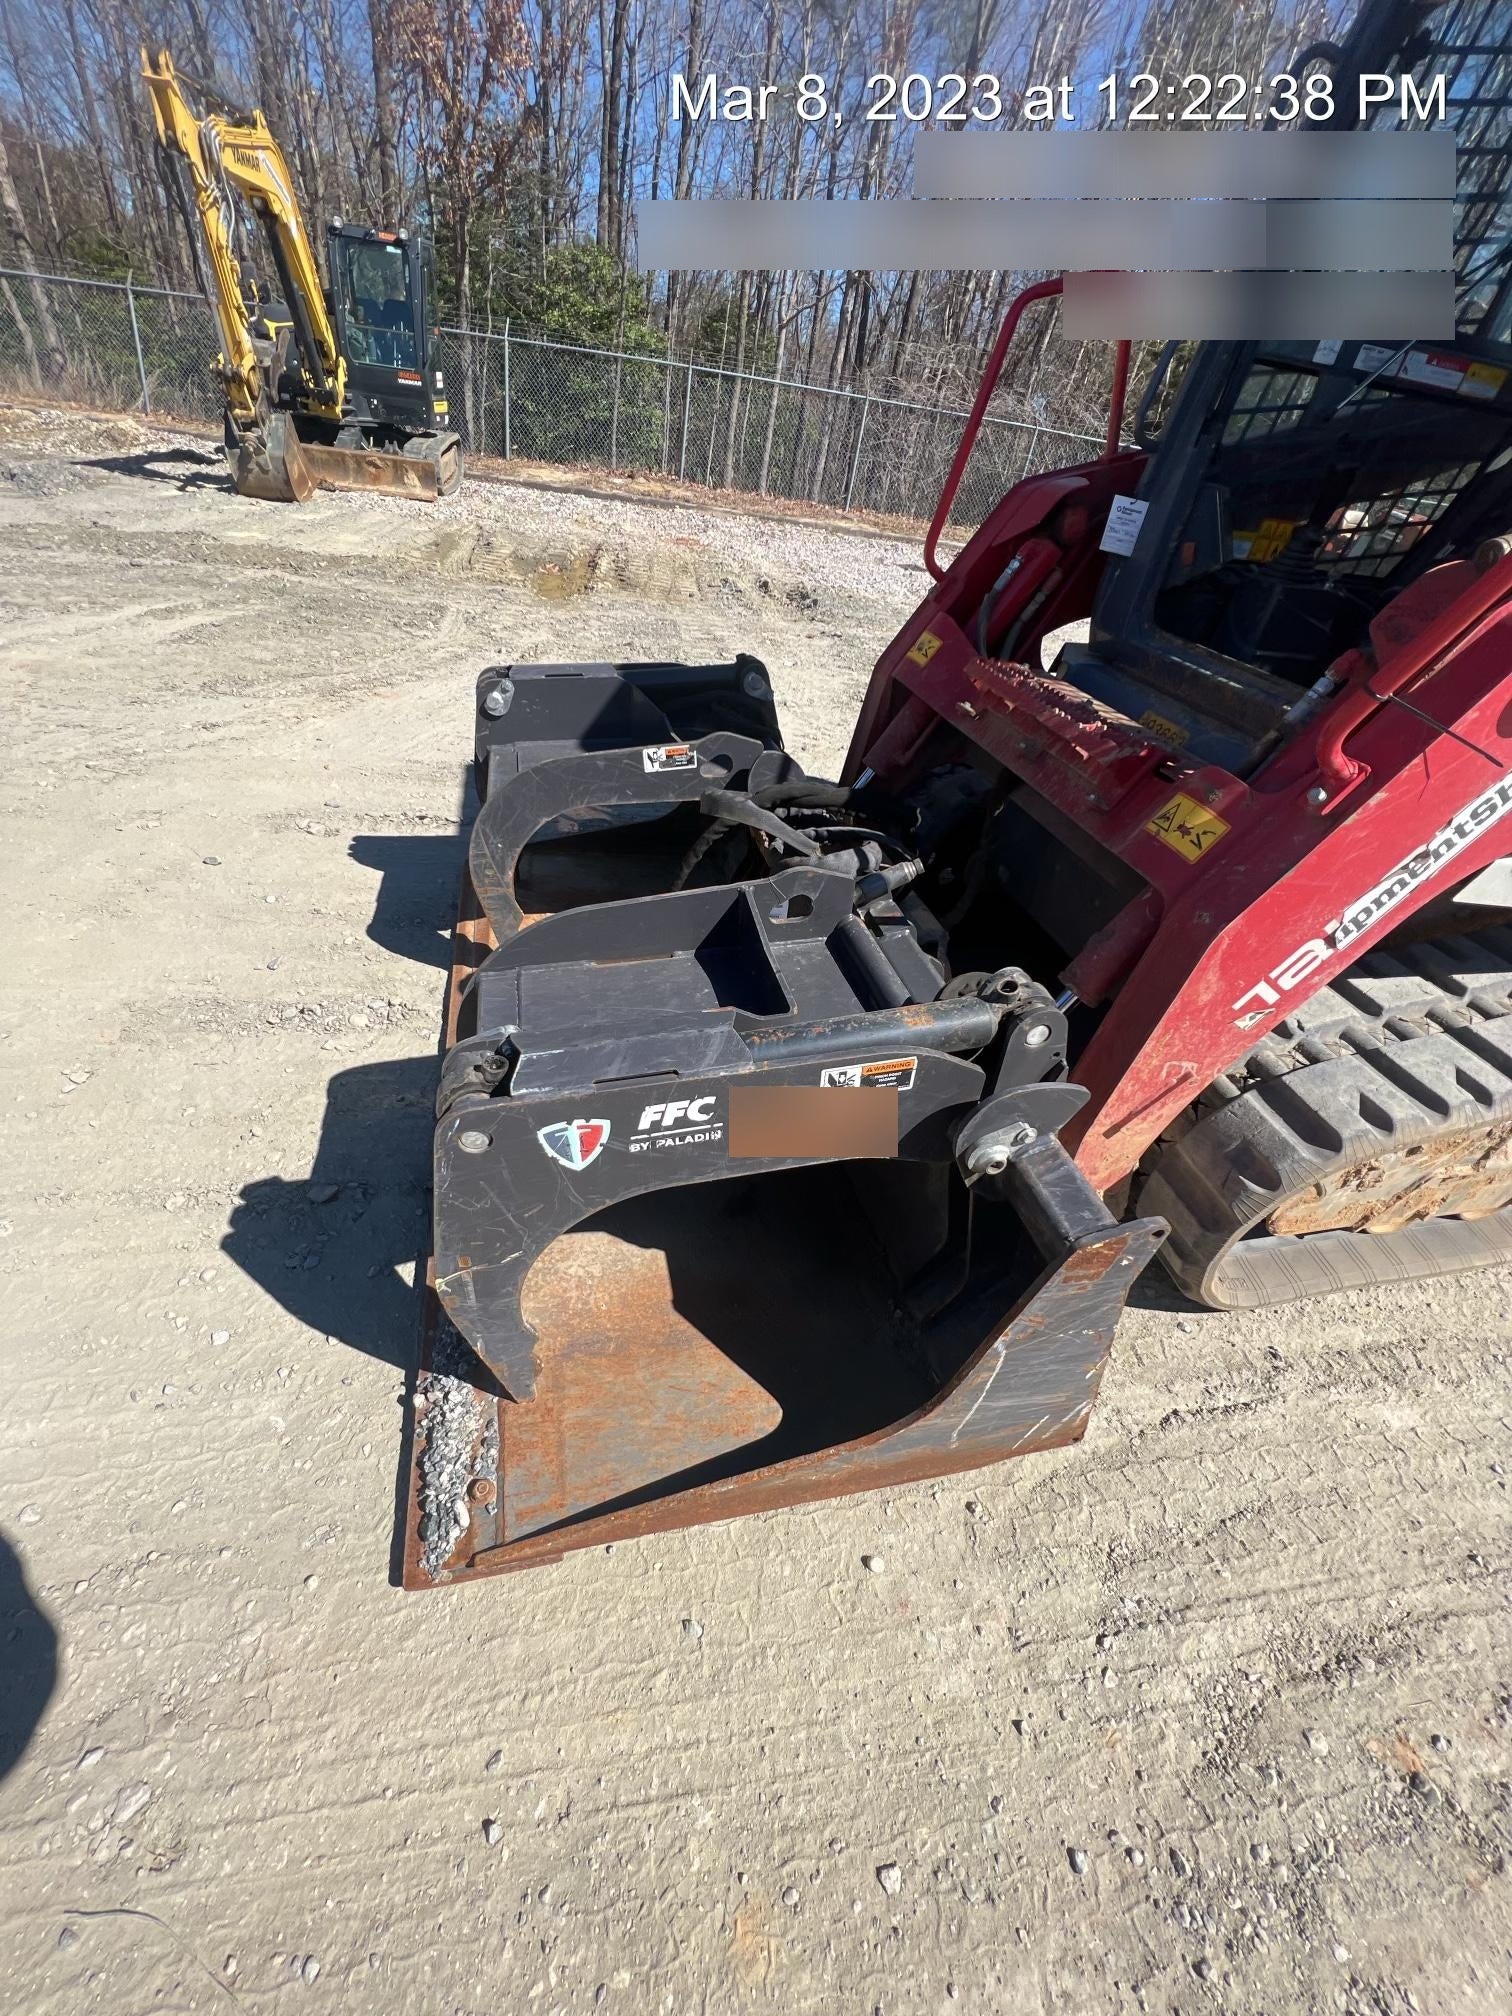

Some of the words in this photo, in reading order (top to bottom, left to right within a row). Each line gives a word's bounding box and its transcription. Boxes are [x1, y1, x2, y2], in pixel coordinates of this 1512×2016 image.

[231, 146, 261, 173] YANMAR
[872, 1061, 911, 1072] WARNING
[638, 1096, 716, 1131] FFC
[629, 1141, 650, 1153] BY
